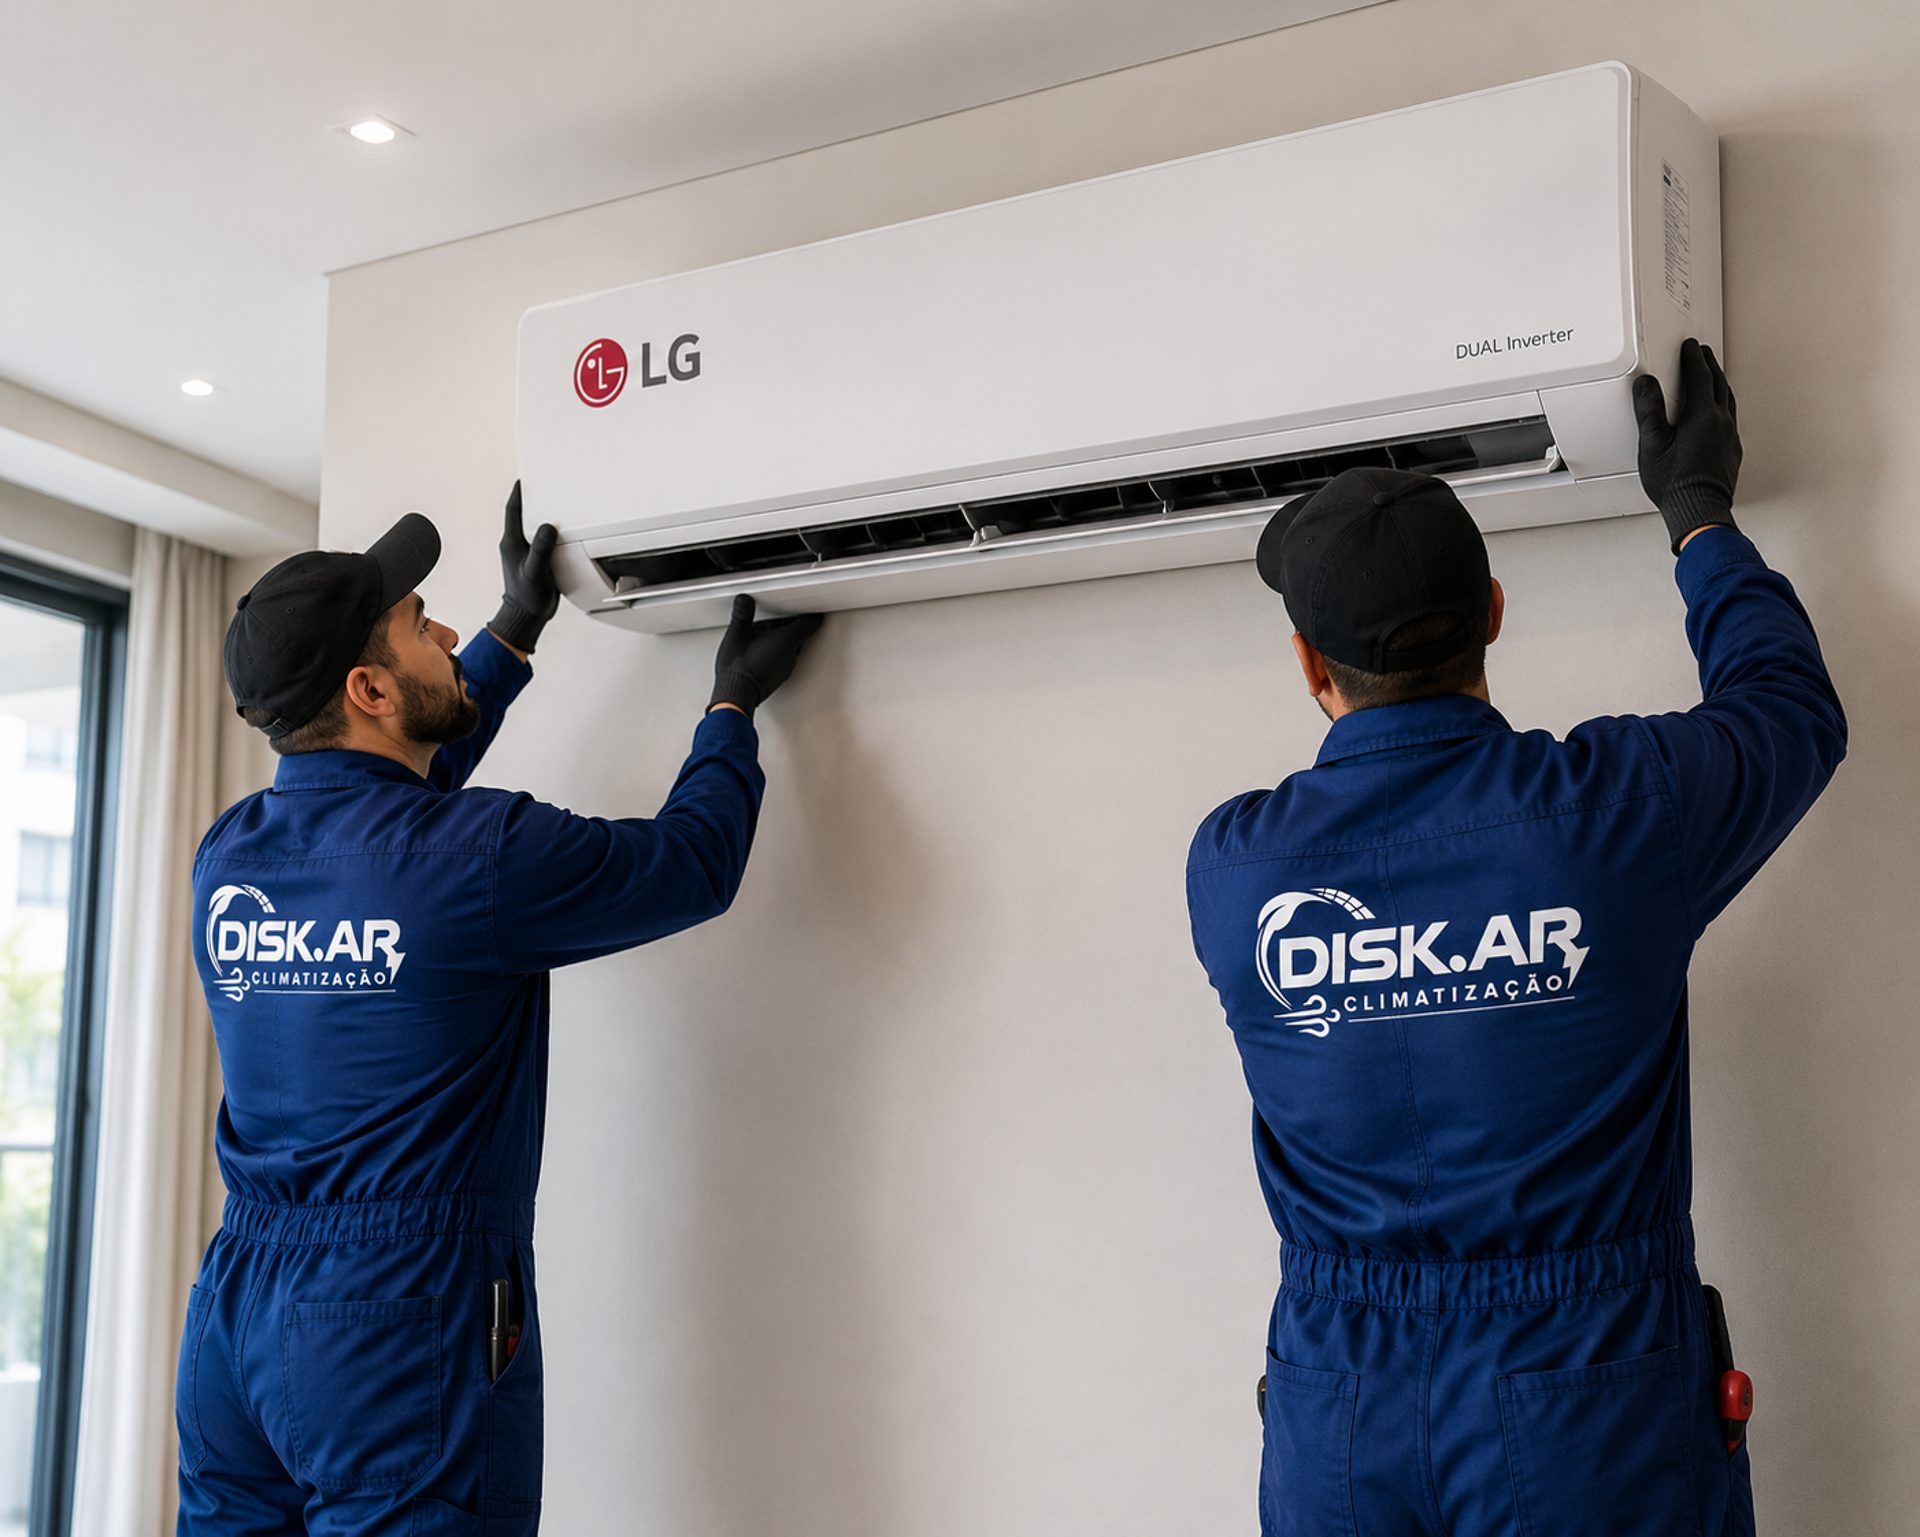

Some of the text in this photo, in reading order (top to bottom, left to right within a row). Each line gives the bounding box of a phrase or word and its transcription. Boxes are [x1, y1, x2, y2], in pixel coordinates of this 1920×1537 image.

[642, 333, 701, 388] LG
[1456, 328, 1574, 359] DUAL Inverter
[218, 919, 406, 984] DISK.AR
[1279, 906, 1590, 989] DISK.AR
[251, 968, 387, 989] CLIMATIZAÇÃO
[1343, 973, 1563, 1013] CLIMATIZAÇÃO
